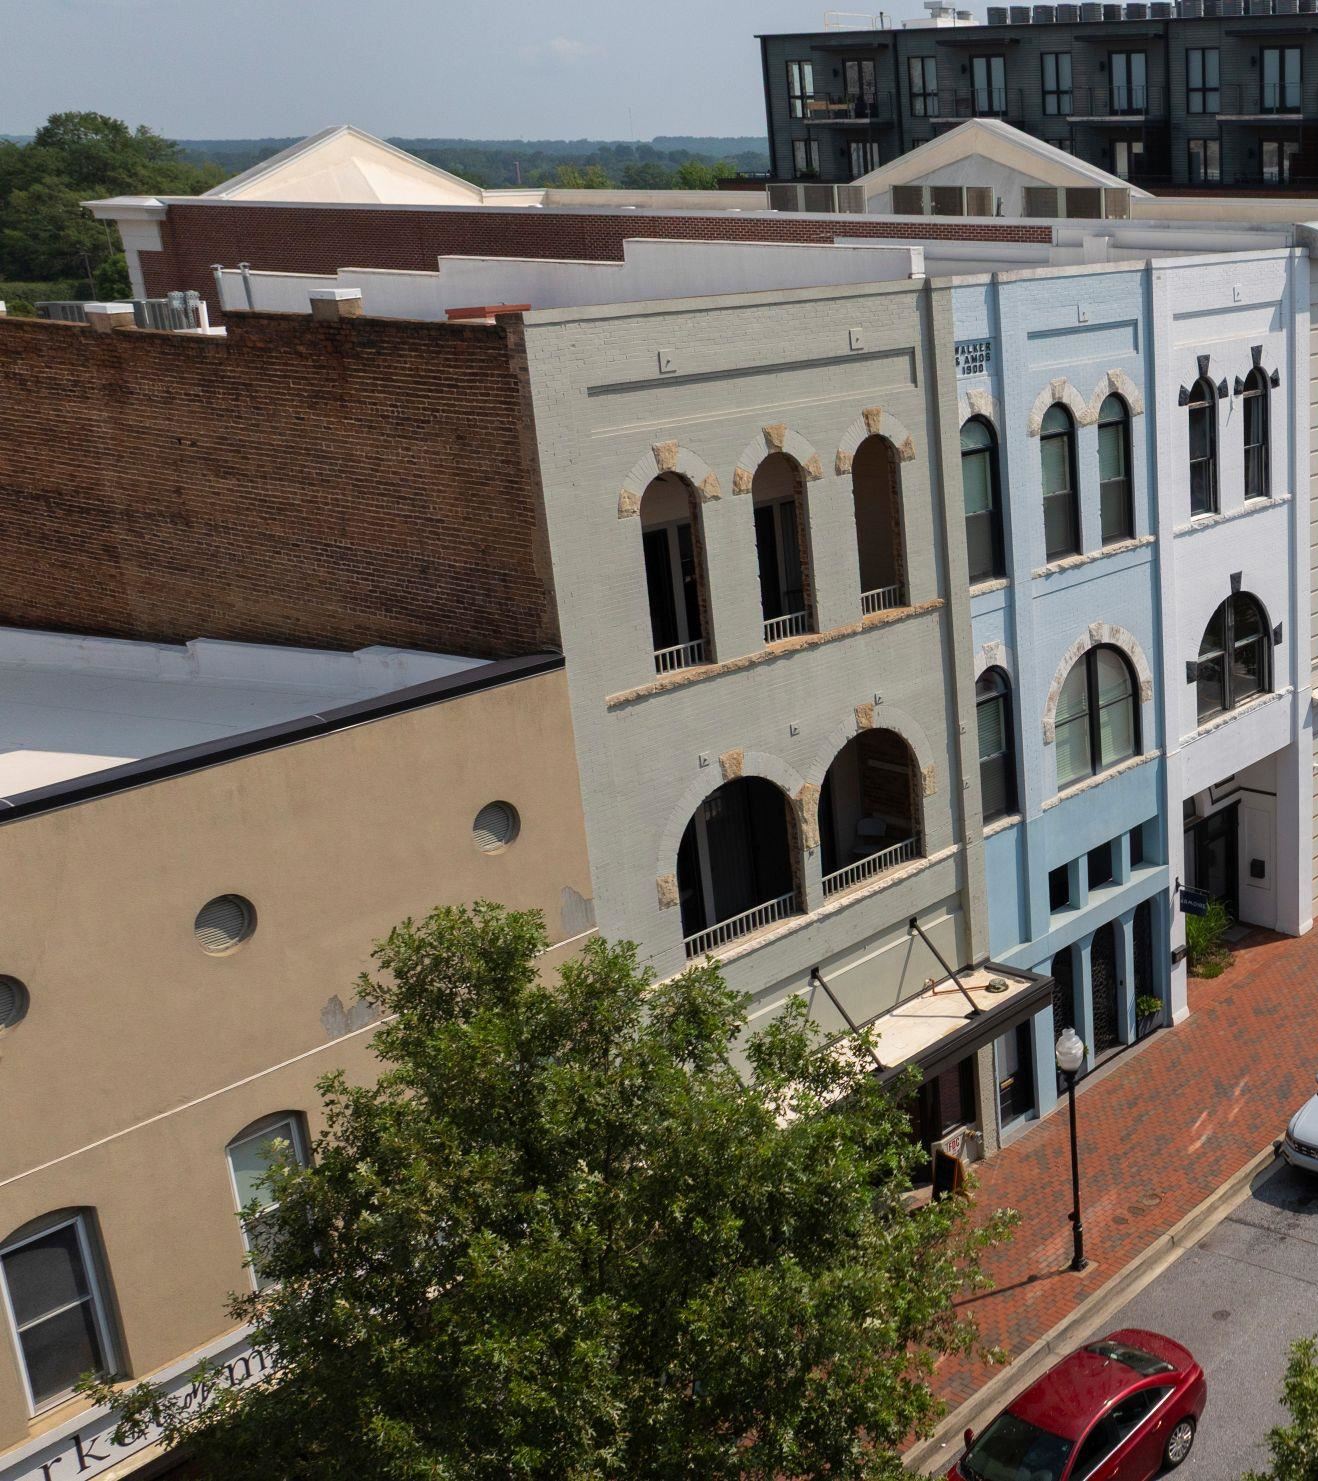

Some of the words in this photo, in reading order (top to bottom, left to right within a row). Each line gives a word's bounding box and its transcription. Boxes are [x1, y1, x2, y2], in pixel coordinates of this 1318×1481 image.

[955, 342, 991, 355] WALKER
[964, 352, 991, 365] AMOS
[961, 363, 984, 375] 1900
